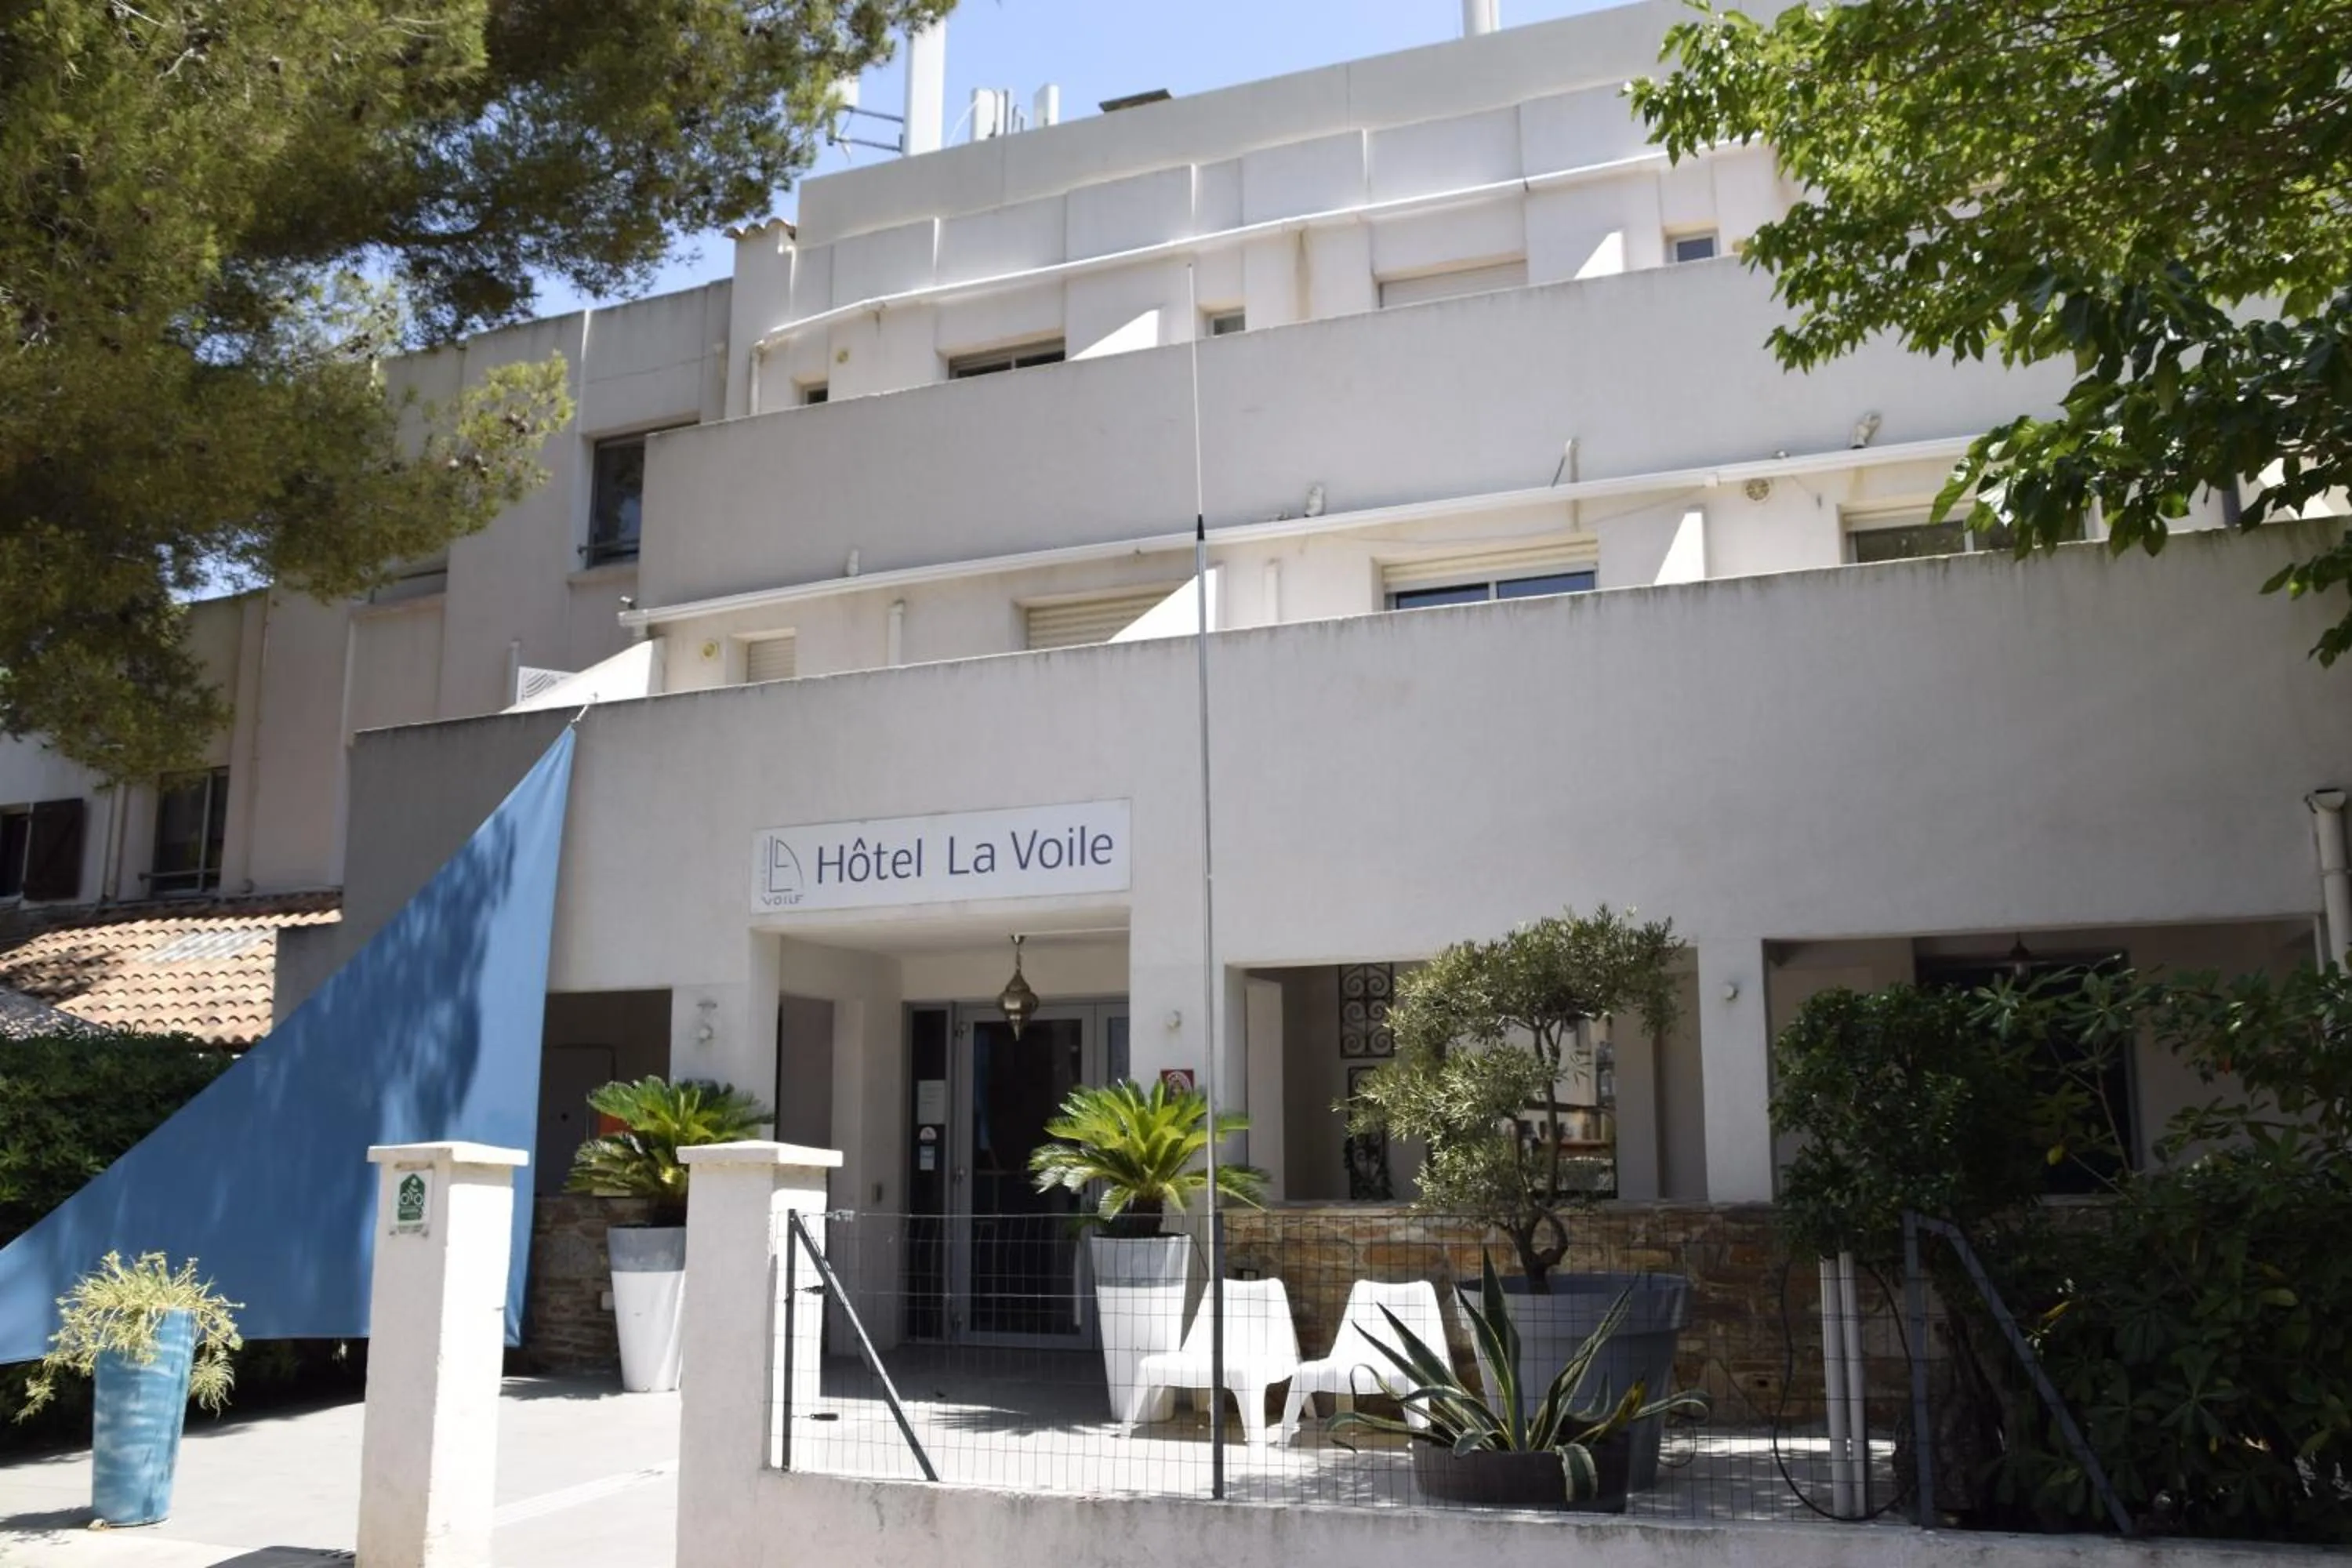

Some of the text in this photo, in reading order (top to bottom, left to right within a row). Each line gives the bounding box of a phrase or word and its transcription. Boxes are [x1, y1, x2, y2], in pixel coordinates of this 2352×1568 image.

[817, 837, 922, 884] Hôtel
[949, 836, 995, 875] La
[1011, 826, 1113, 870] Voile
